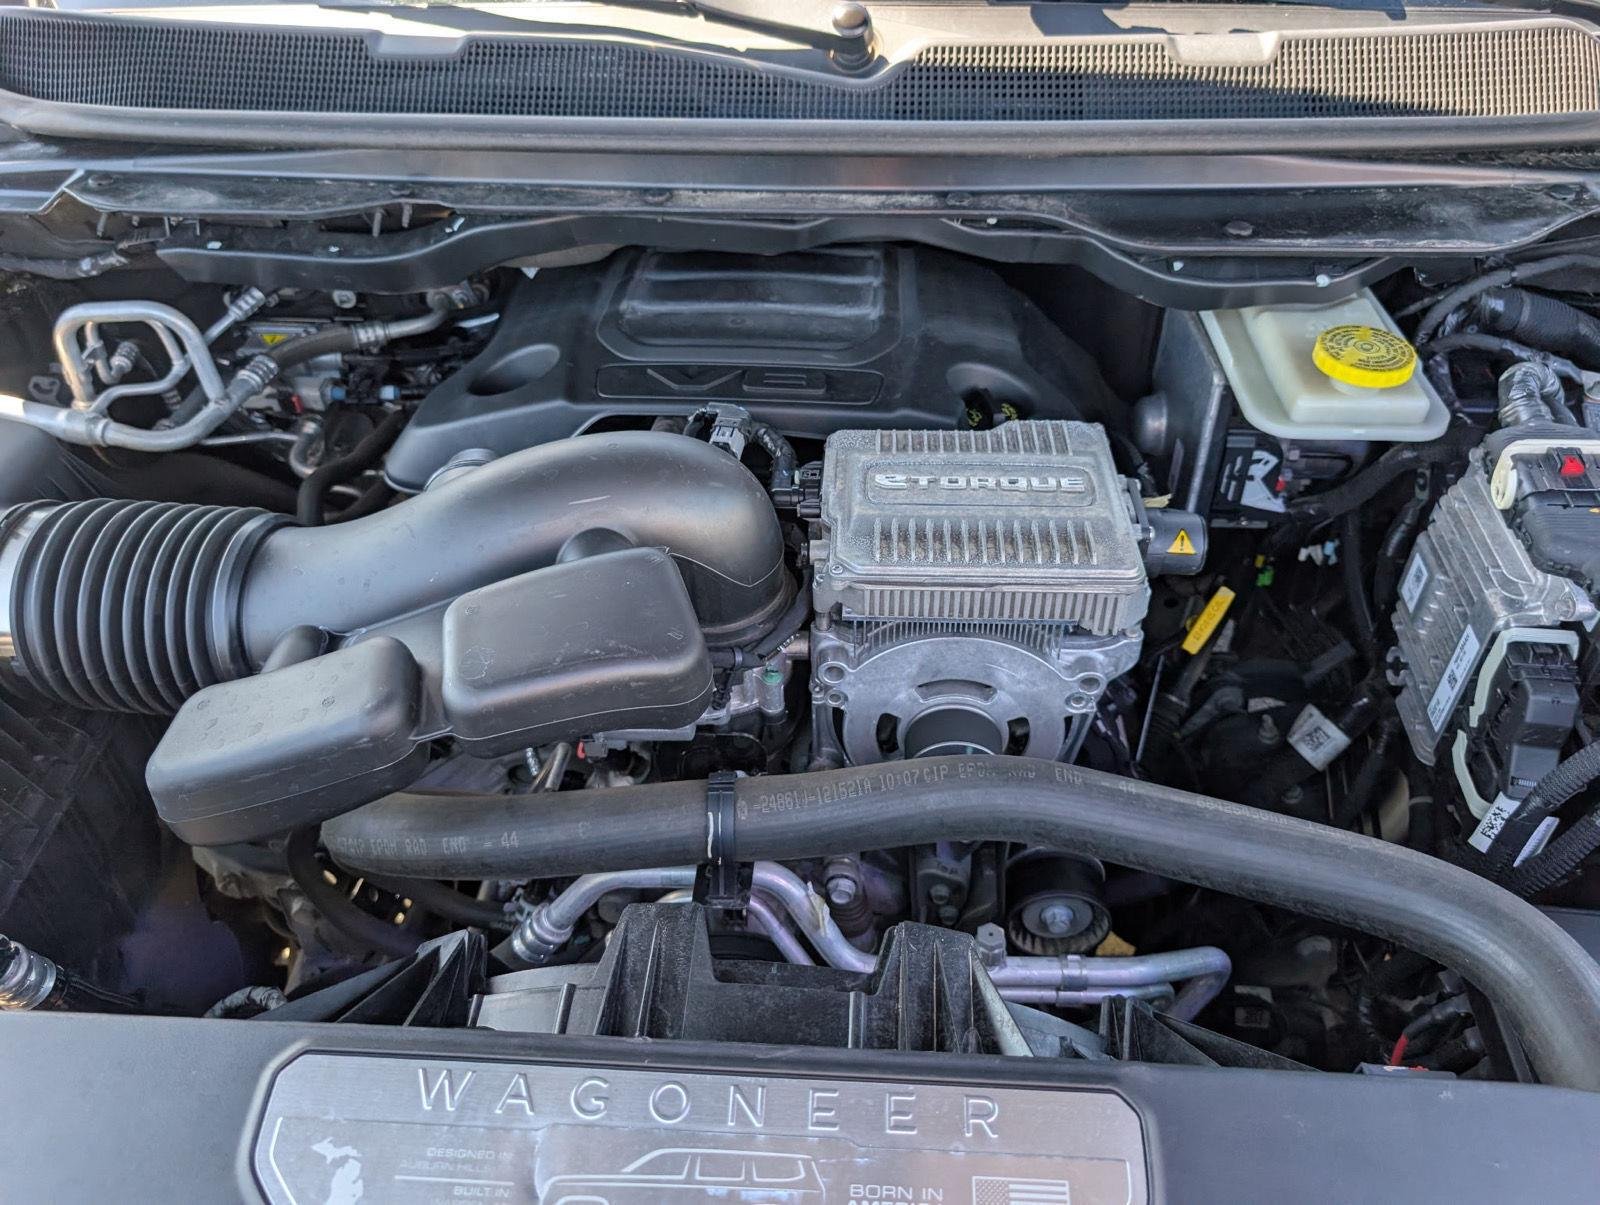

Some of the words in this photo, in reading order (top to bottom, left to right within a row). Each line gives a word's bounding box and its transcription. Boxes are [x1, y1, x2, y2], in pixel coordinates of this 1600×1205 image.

[500, 830, 521, 849] 44
[417, 1067, 999, 1139] WAGONEER
[426, 1147, 496, 1160] DESIGNED
[453, 1185, 492, 1197] BUILT
[495, 1187, 511, 1199] IN
[849, 1183, 914, 1200] BORN
[922, 1187, 943, 1201] IN
